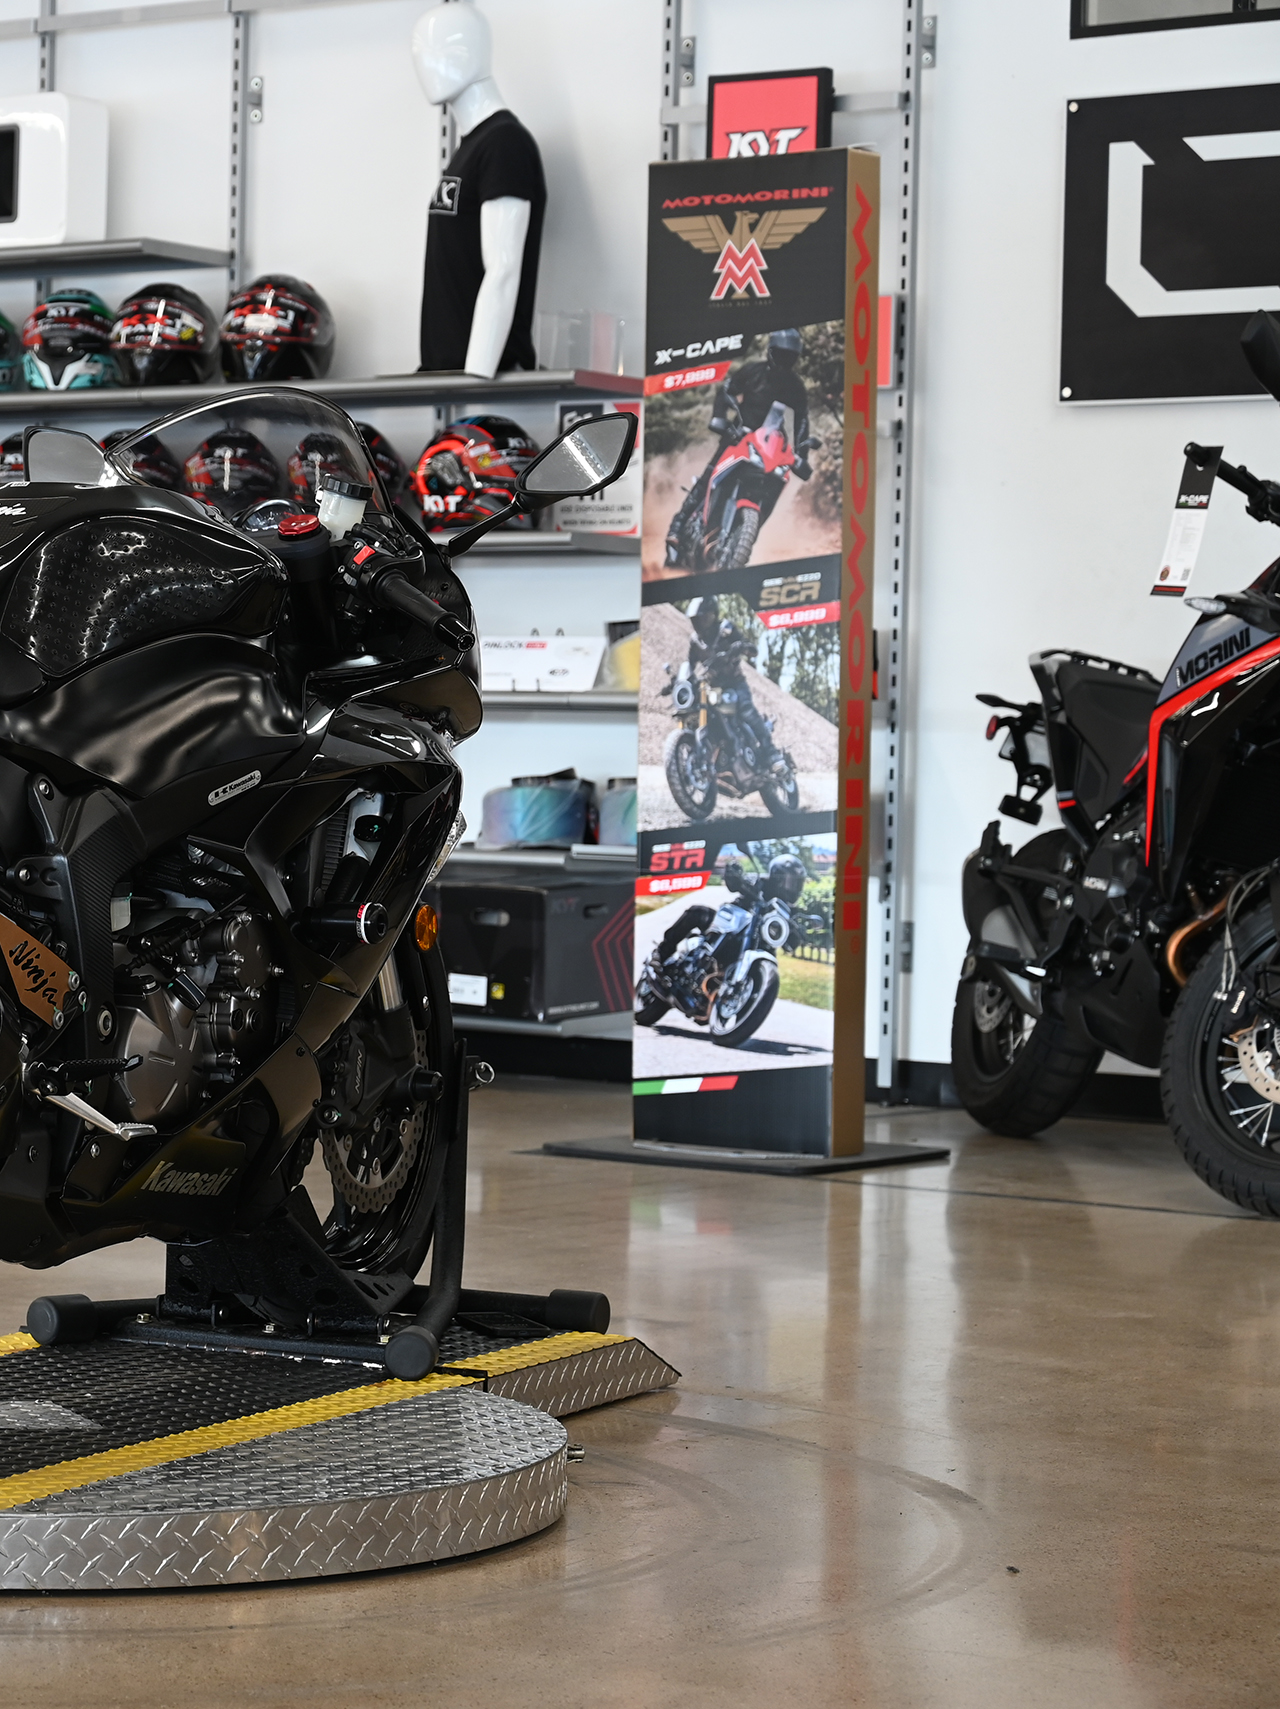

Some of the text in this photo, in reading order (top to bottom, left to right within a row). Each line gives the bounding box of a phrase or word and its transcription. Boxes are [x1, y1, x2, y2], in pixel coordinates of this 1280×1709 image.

[662, 186, 830, 209] MOTOMORINI
[654, 333, 744, 365] X-CAPE
[422, 494, 463, 512] KYT
[759, 581, 821, 607] SCR
[1179, 626, 1251, 684] MORINI
[649, 848, 706, 872] STR
[9, 940, 58, 1006] Ninja
[141, 1160, 238, 1196] Kawasaki
